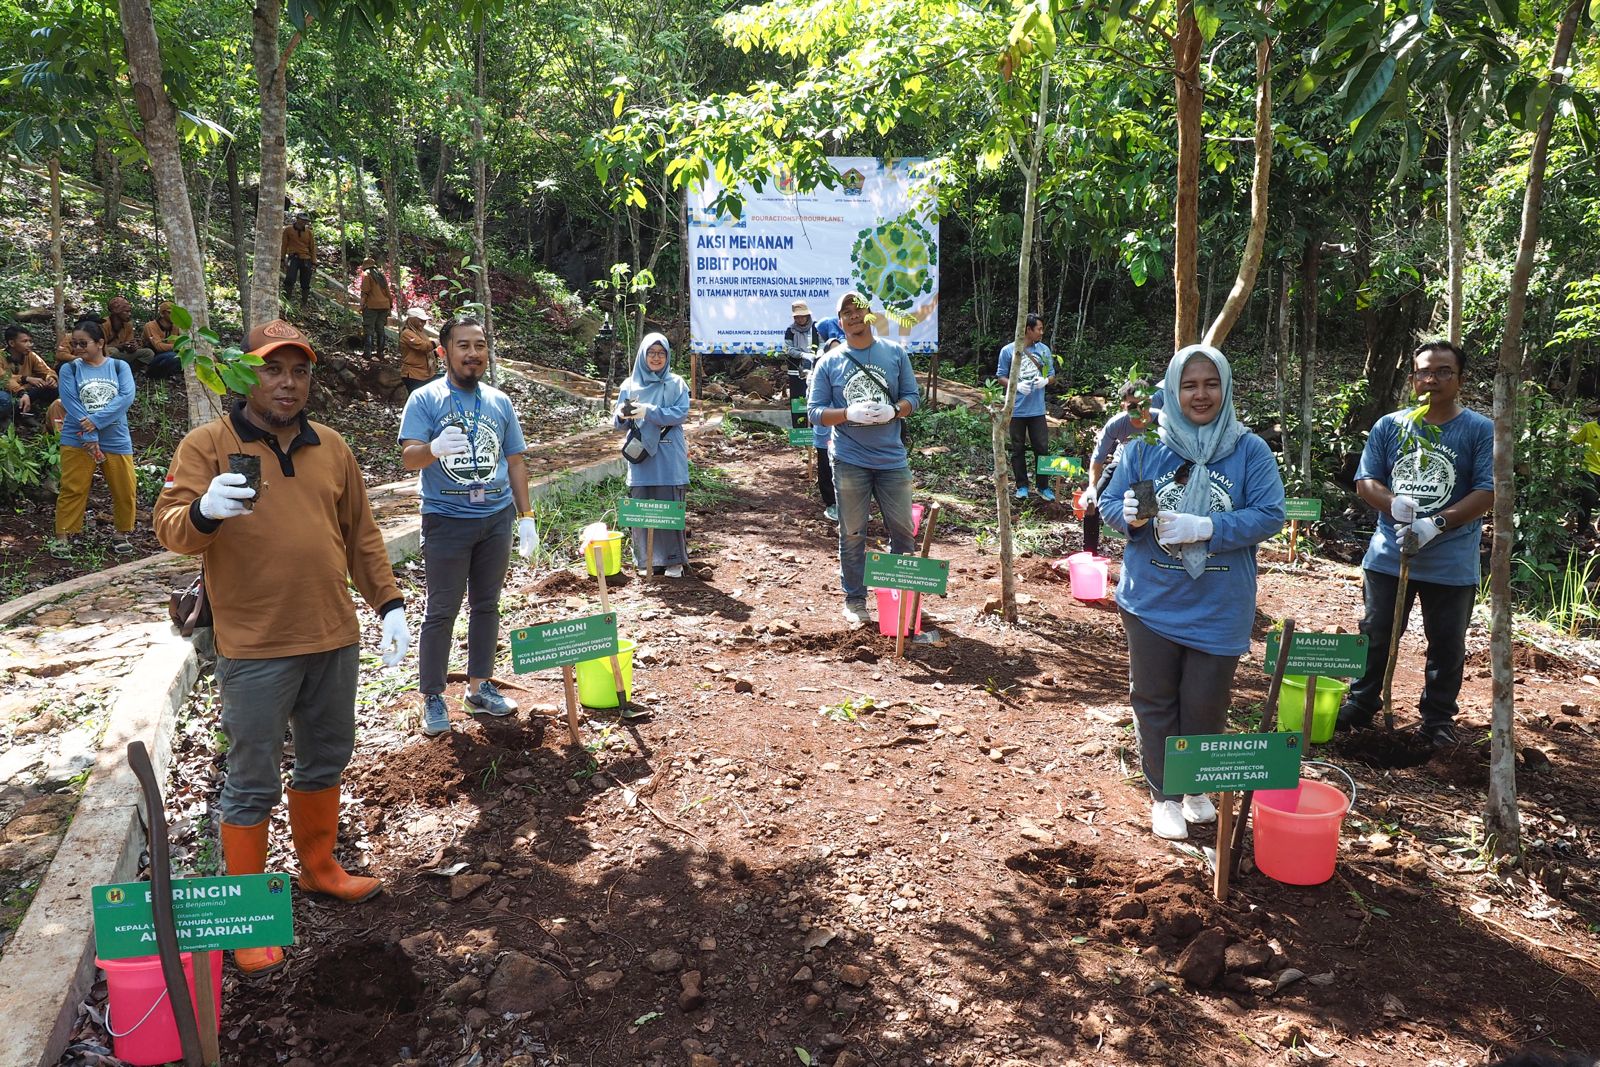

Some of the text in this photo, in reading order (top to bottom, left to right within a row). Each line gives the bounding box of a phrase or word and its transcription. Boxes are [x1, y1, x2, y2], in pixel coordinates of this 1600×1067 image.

[751, 215, 844, 223] #OURACTIONSFOROURPLANET
[697, 235, 794, 250] AKSI MENANAM
[697, 257, 778, 271] BIBIT POHON
[697, 276, 708, 285] PT.
[709, 277, 739, 285] HASNUR
[740, 277, 798, 285] INTERNASIONAL
[799, 277, 834, 286] SHIPPING,
[697, 289, 829, 298] DI TAMAN HUTAN RAYA SULTAN ADAM
[454, 456, 490, 465] POHON
[1399, 483, 1438, 493] POHON
[897, 559, 919, 567] PETE
[541, 622, 587, 638] MAHONI
[1295, 638, 1339, 647] MAHONI
[520, 652, 558, 666] RAHMAD
[559, 641, 612, 658] PUDJOTOMO
[1201, 740, 1268, 751] BERINGIN
[1195, 771, 1269, 782] JAYANTI SARI
[144, 884, 242, 903] BRINGIN
[114, 923, 150, 932] KEPALA
[177, 919, 213, 927] TAHURA
[214, 916, 247, 924] SULTAN
[249, 914, 274, 922] ADAM
[196, 924, 253, 938] JARIAH
